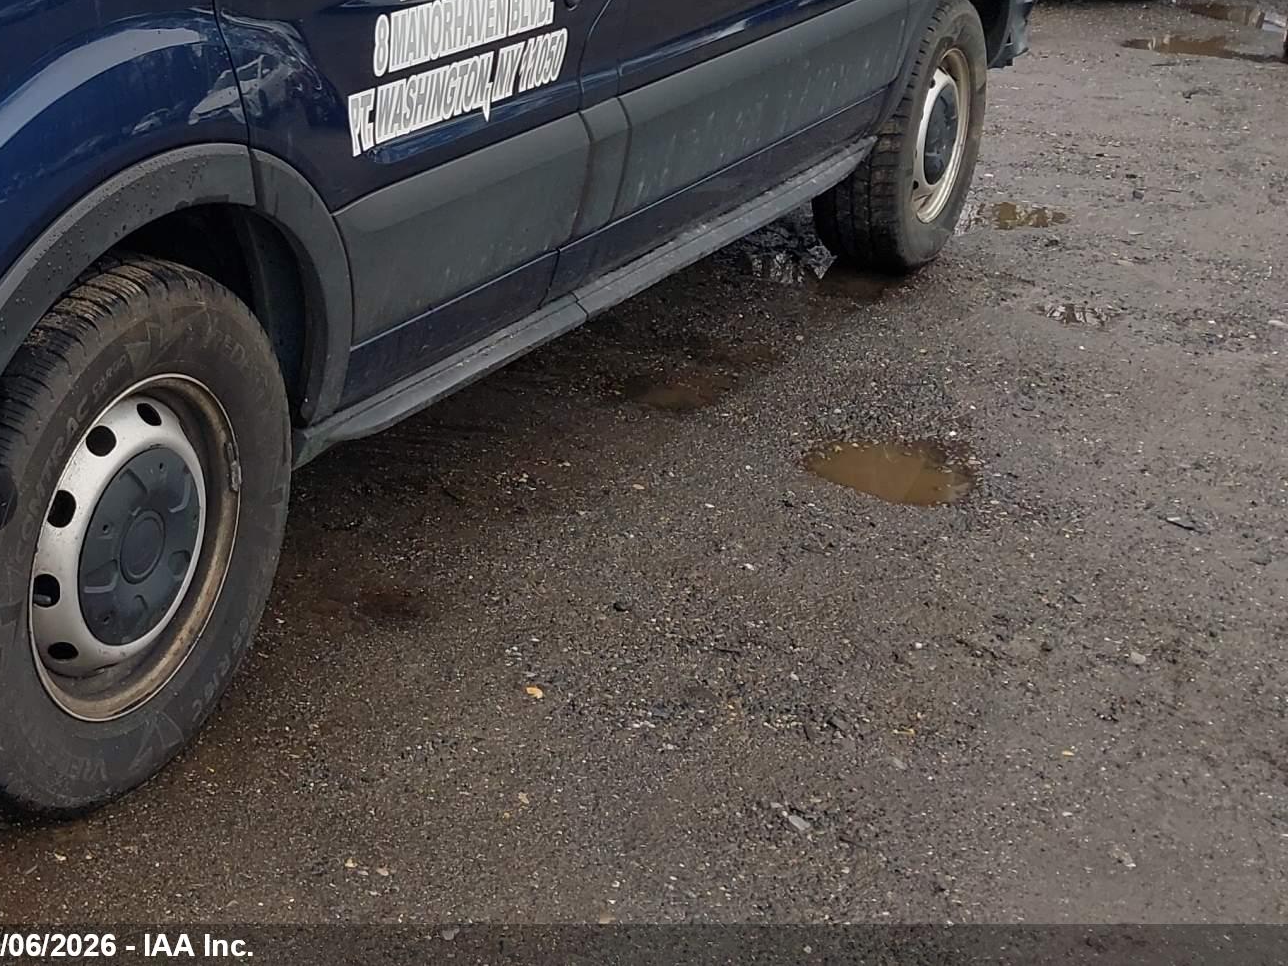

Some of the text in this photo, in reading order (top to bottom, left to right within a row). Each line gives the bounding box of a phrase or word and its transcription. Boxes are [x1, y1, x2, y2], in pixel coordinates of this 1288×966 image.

[373, 13, 390, 77] 8
[491, 41, 526, 103] NY
[518, 27, 568, 94] 11050
